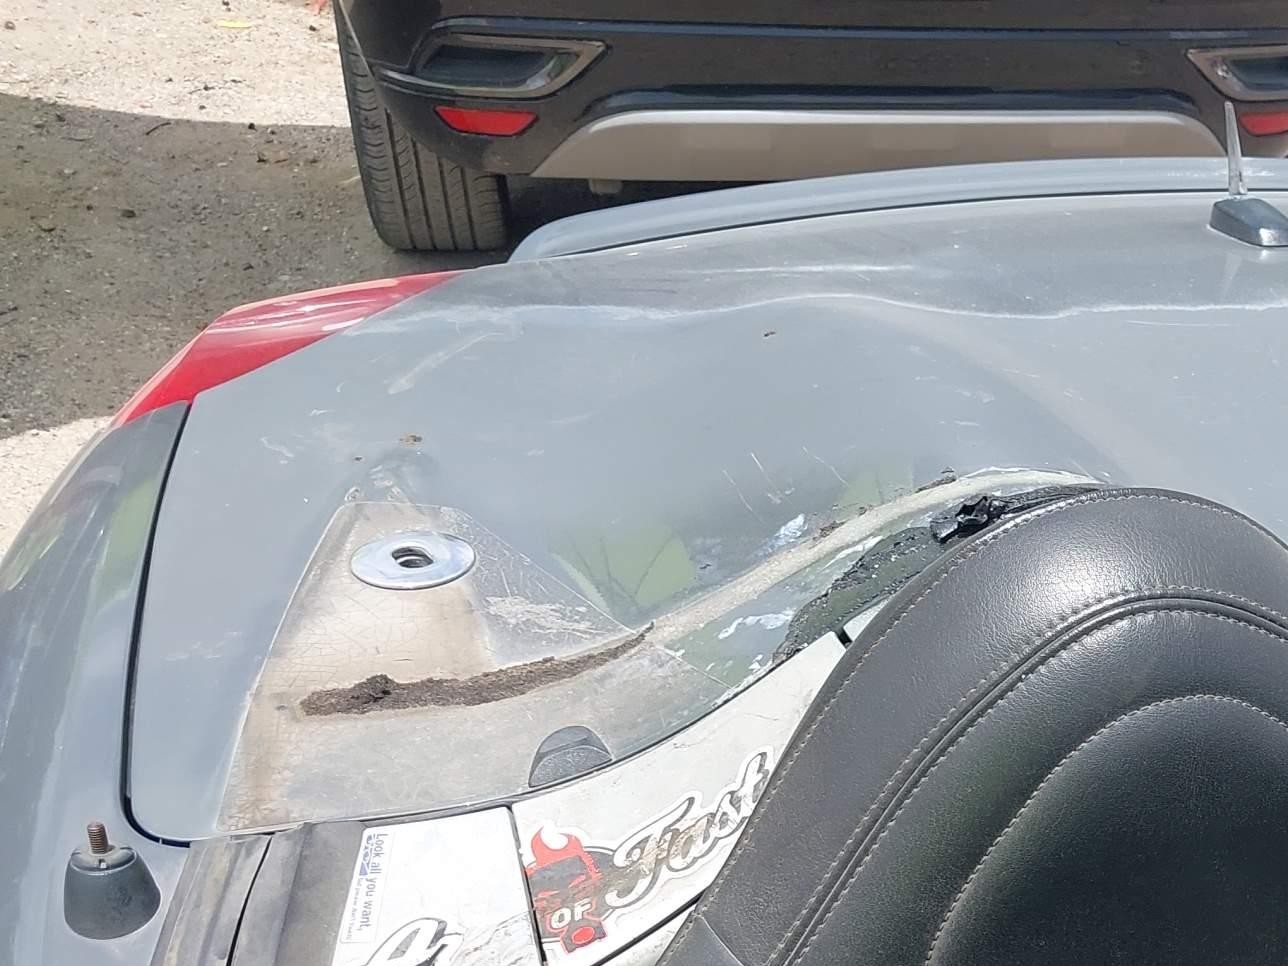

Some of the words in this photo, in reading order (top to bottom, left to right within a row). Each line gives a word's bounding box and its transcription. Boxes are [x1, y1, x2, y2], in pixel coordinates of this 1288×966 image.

[372, 832, 389, 859] Look
[370, 861, 382, 875] all
[365, 877, 379, 898] you
[550, 900, 593, 930] OF
